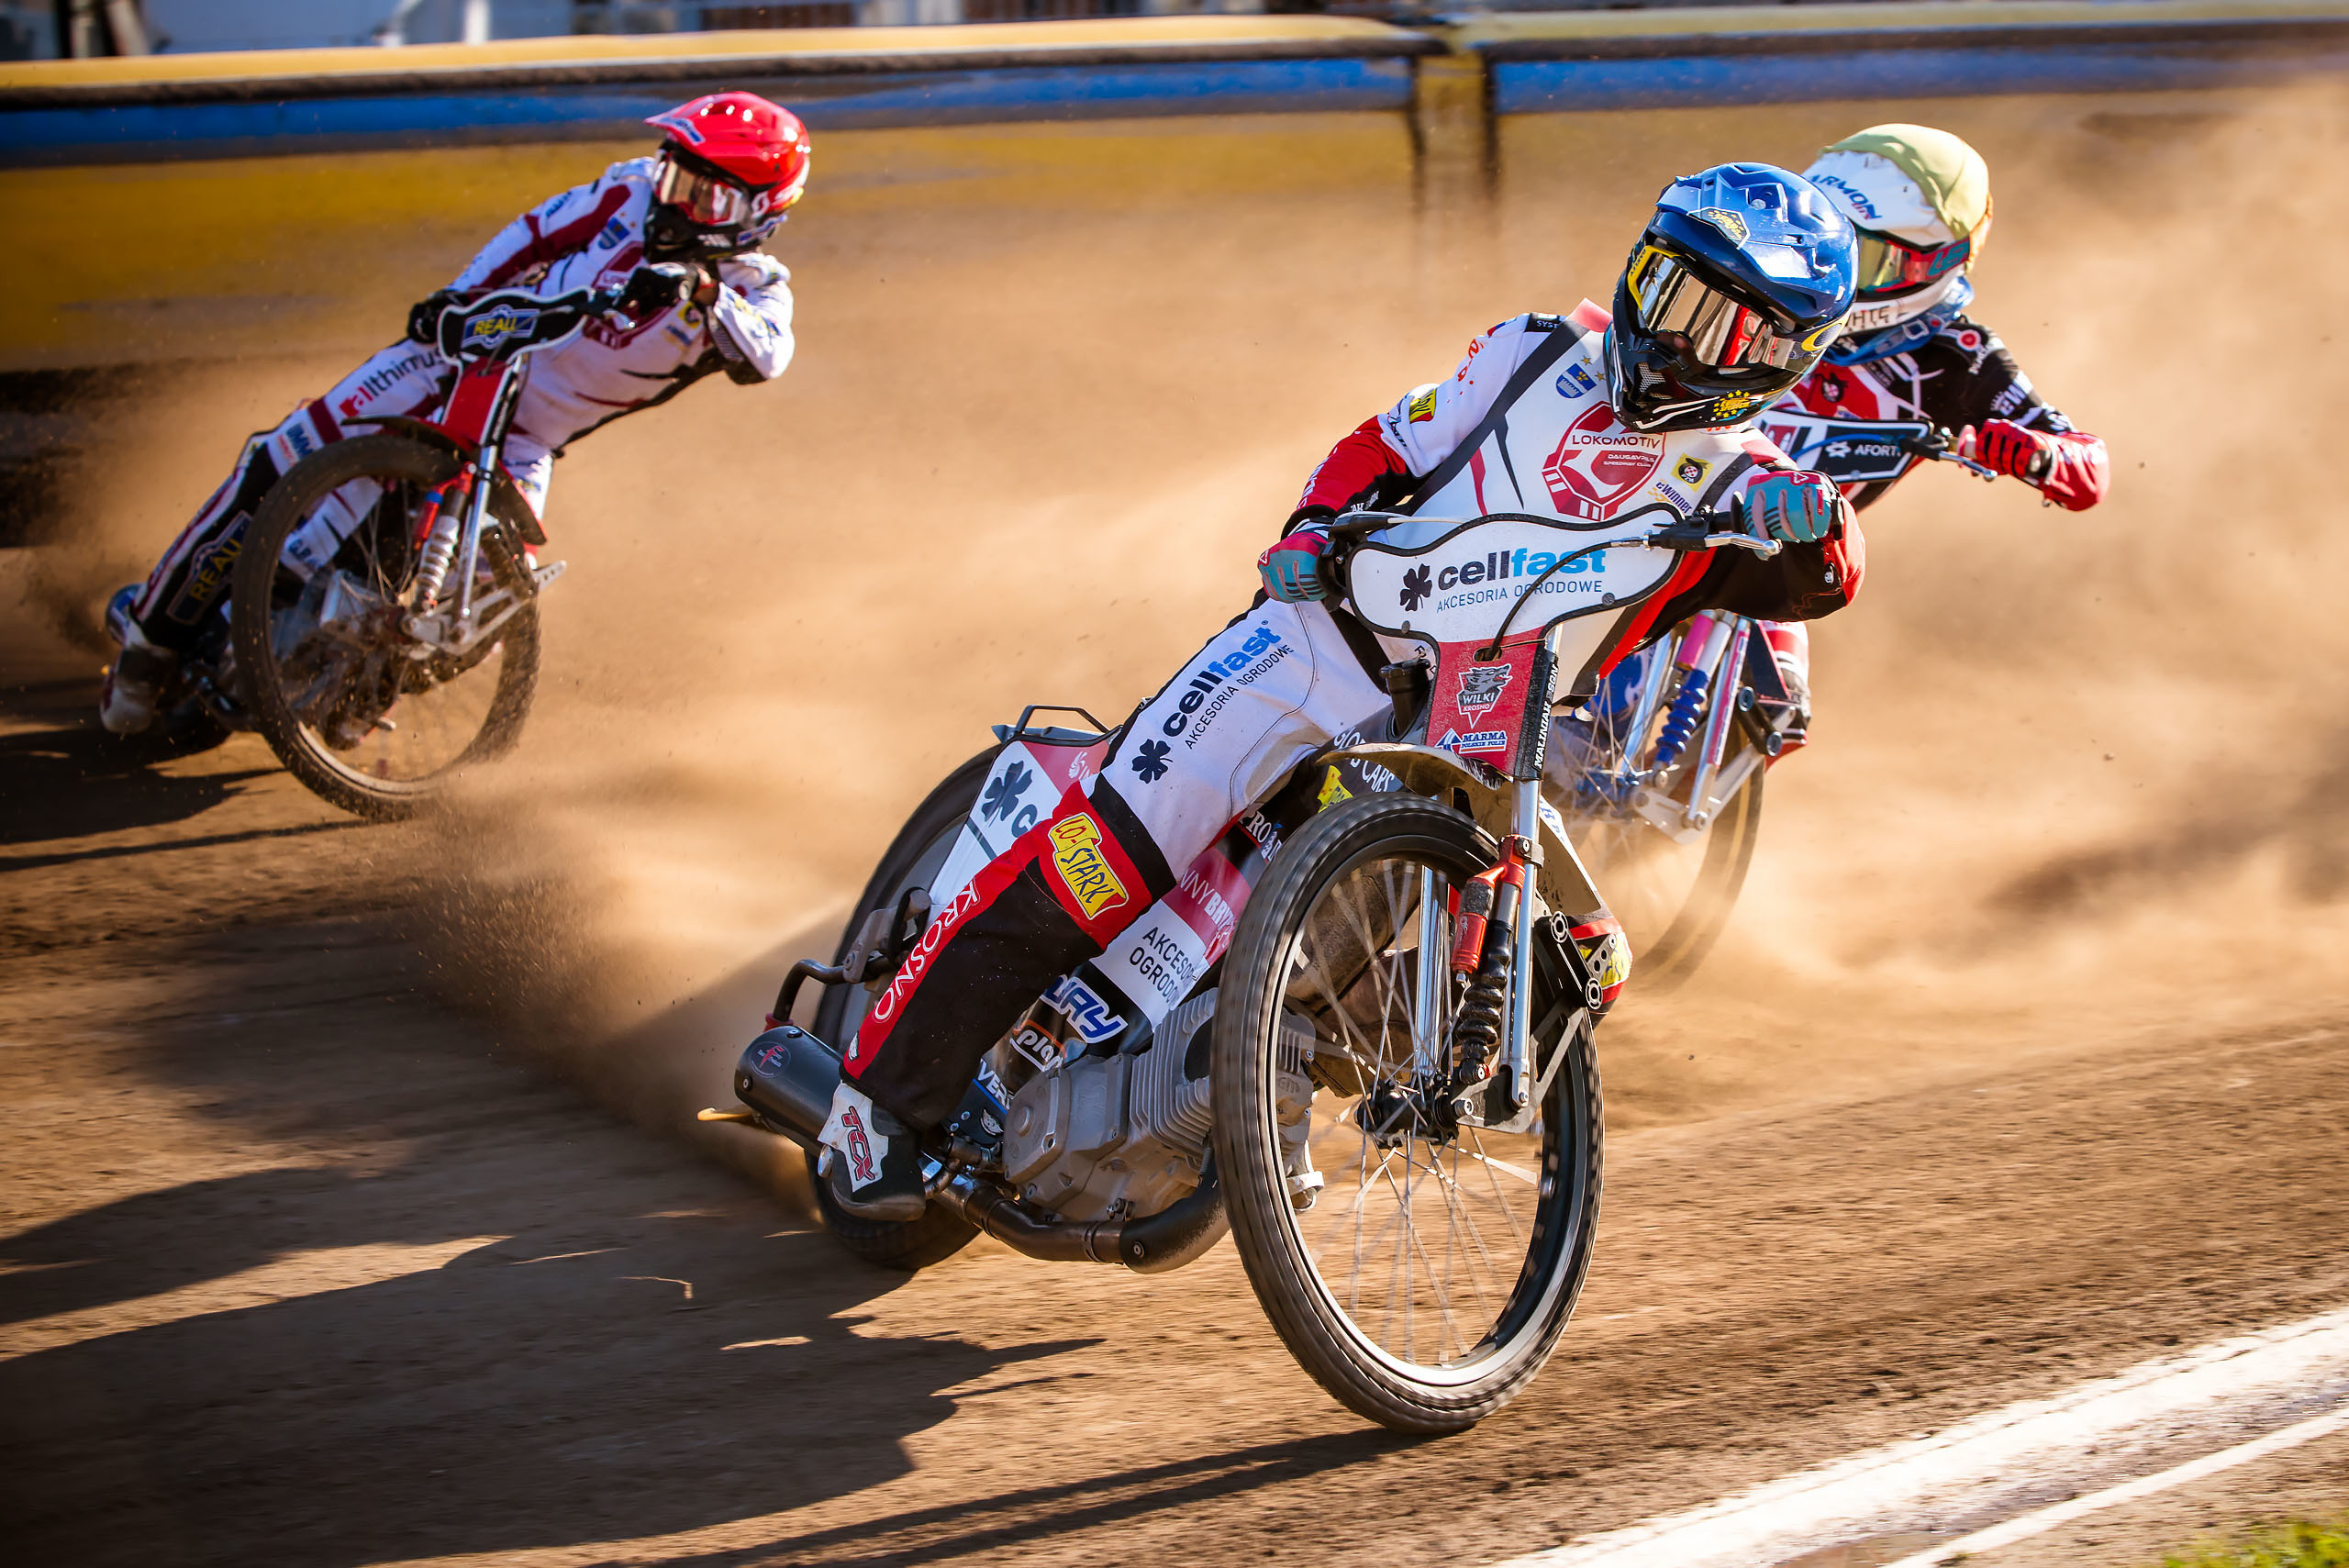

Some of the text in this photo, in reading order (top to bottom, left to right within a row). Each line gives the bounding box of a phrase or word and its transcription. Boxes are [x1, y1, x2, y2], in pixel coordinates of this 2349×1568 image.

[1572, 435, 1661, 450] LOKOMOTIV
[1438, 548, 1606, 591] cellfast
[1436, 587, 1508, 614] AKCESORIA
[1163, 627, 1282, 738] cellfast
[1462, 692, 1495, 705] WILKI
[1185, 685, 1239, 750] AKCESORIA
[1463, 703, 1490, 712] KROSNO
[1462, 731, 1507, 743] MARMA
[1060, 848, 1115, 904] STARK
[874, 881, 979, 1020] KROSNO
[841, 1106, 875, 1182] TCX
